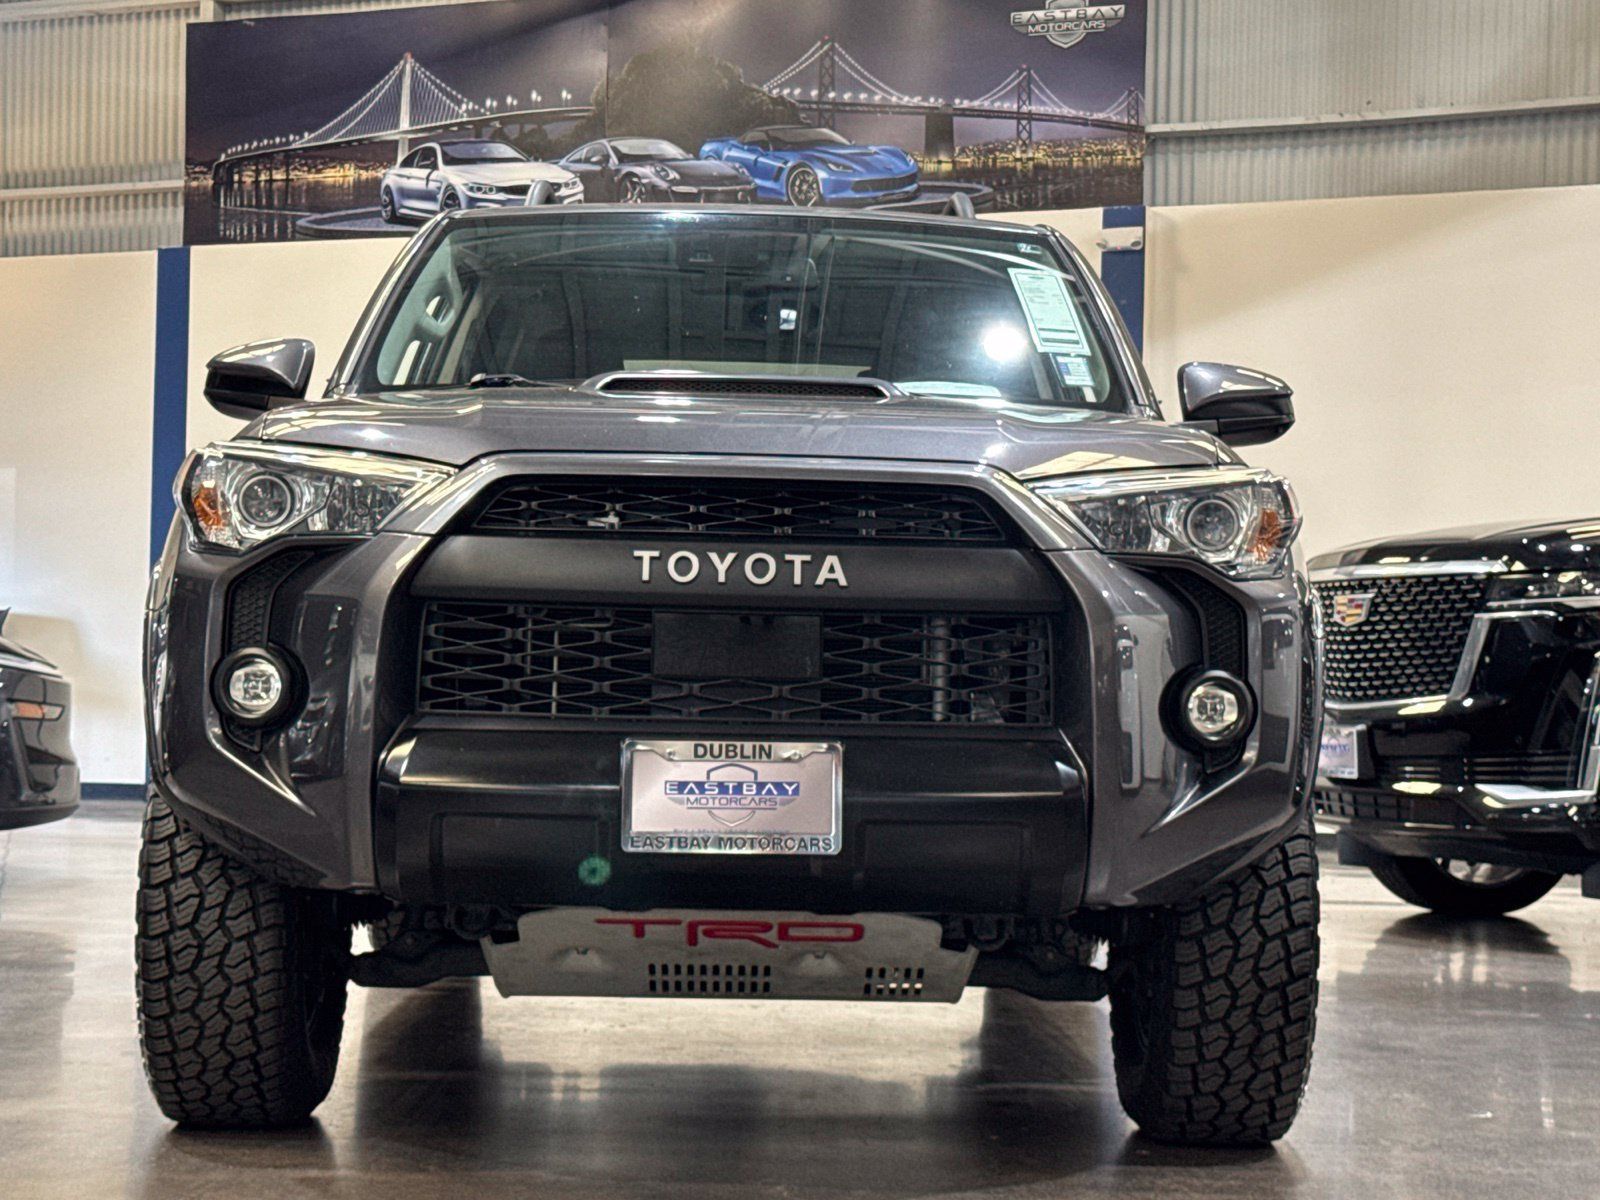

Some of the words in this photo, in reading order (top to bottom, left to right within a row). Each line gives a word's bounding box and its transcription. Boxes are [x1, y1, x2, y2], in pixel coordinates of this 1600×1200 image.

[1012, 6, 1123, 24] EASTBAY
[1028, 20, 1106, 33] MOTORCARS
[633, 550, 848, 586] TOYOTA
[693, 743, 773, 760] DUBLIN
[666, 782, 798, 795] EASTBAY
[686, 796, 778, 807] MOTORCARS
[630, 836, 711, 849] EASTBAY
[718, 836, 833, 851] MOTORCARS
[595, 918, 864, 949] TRD
